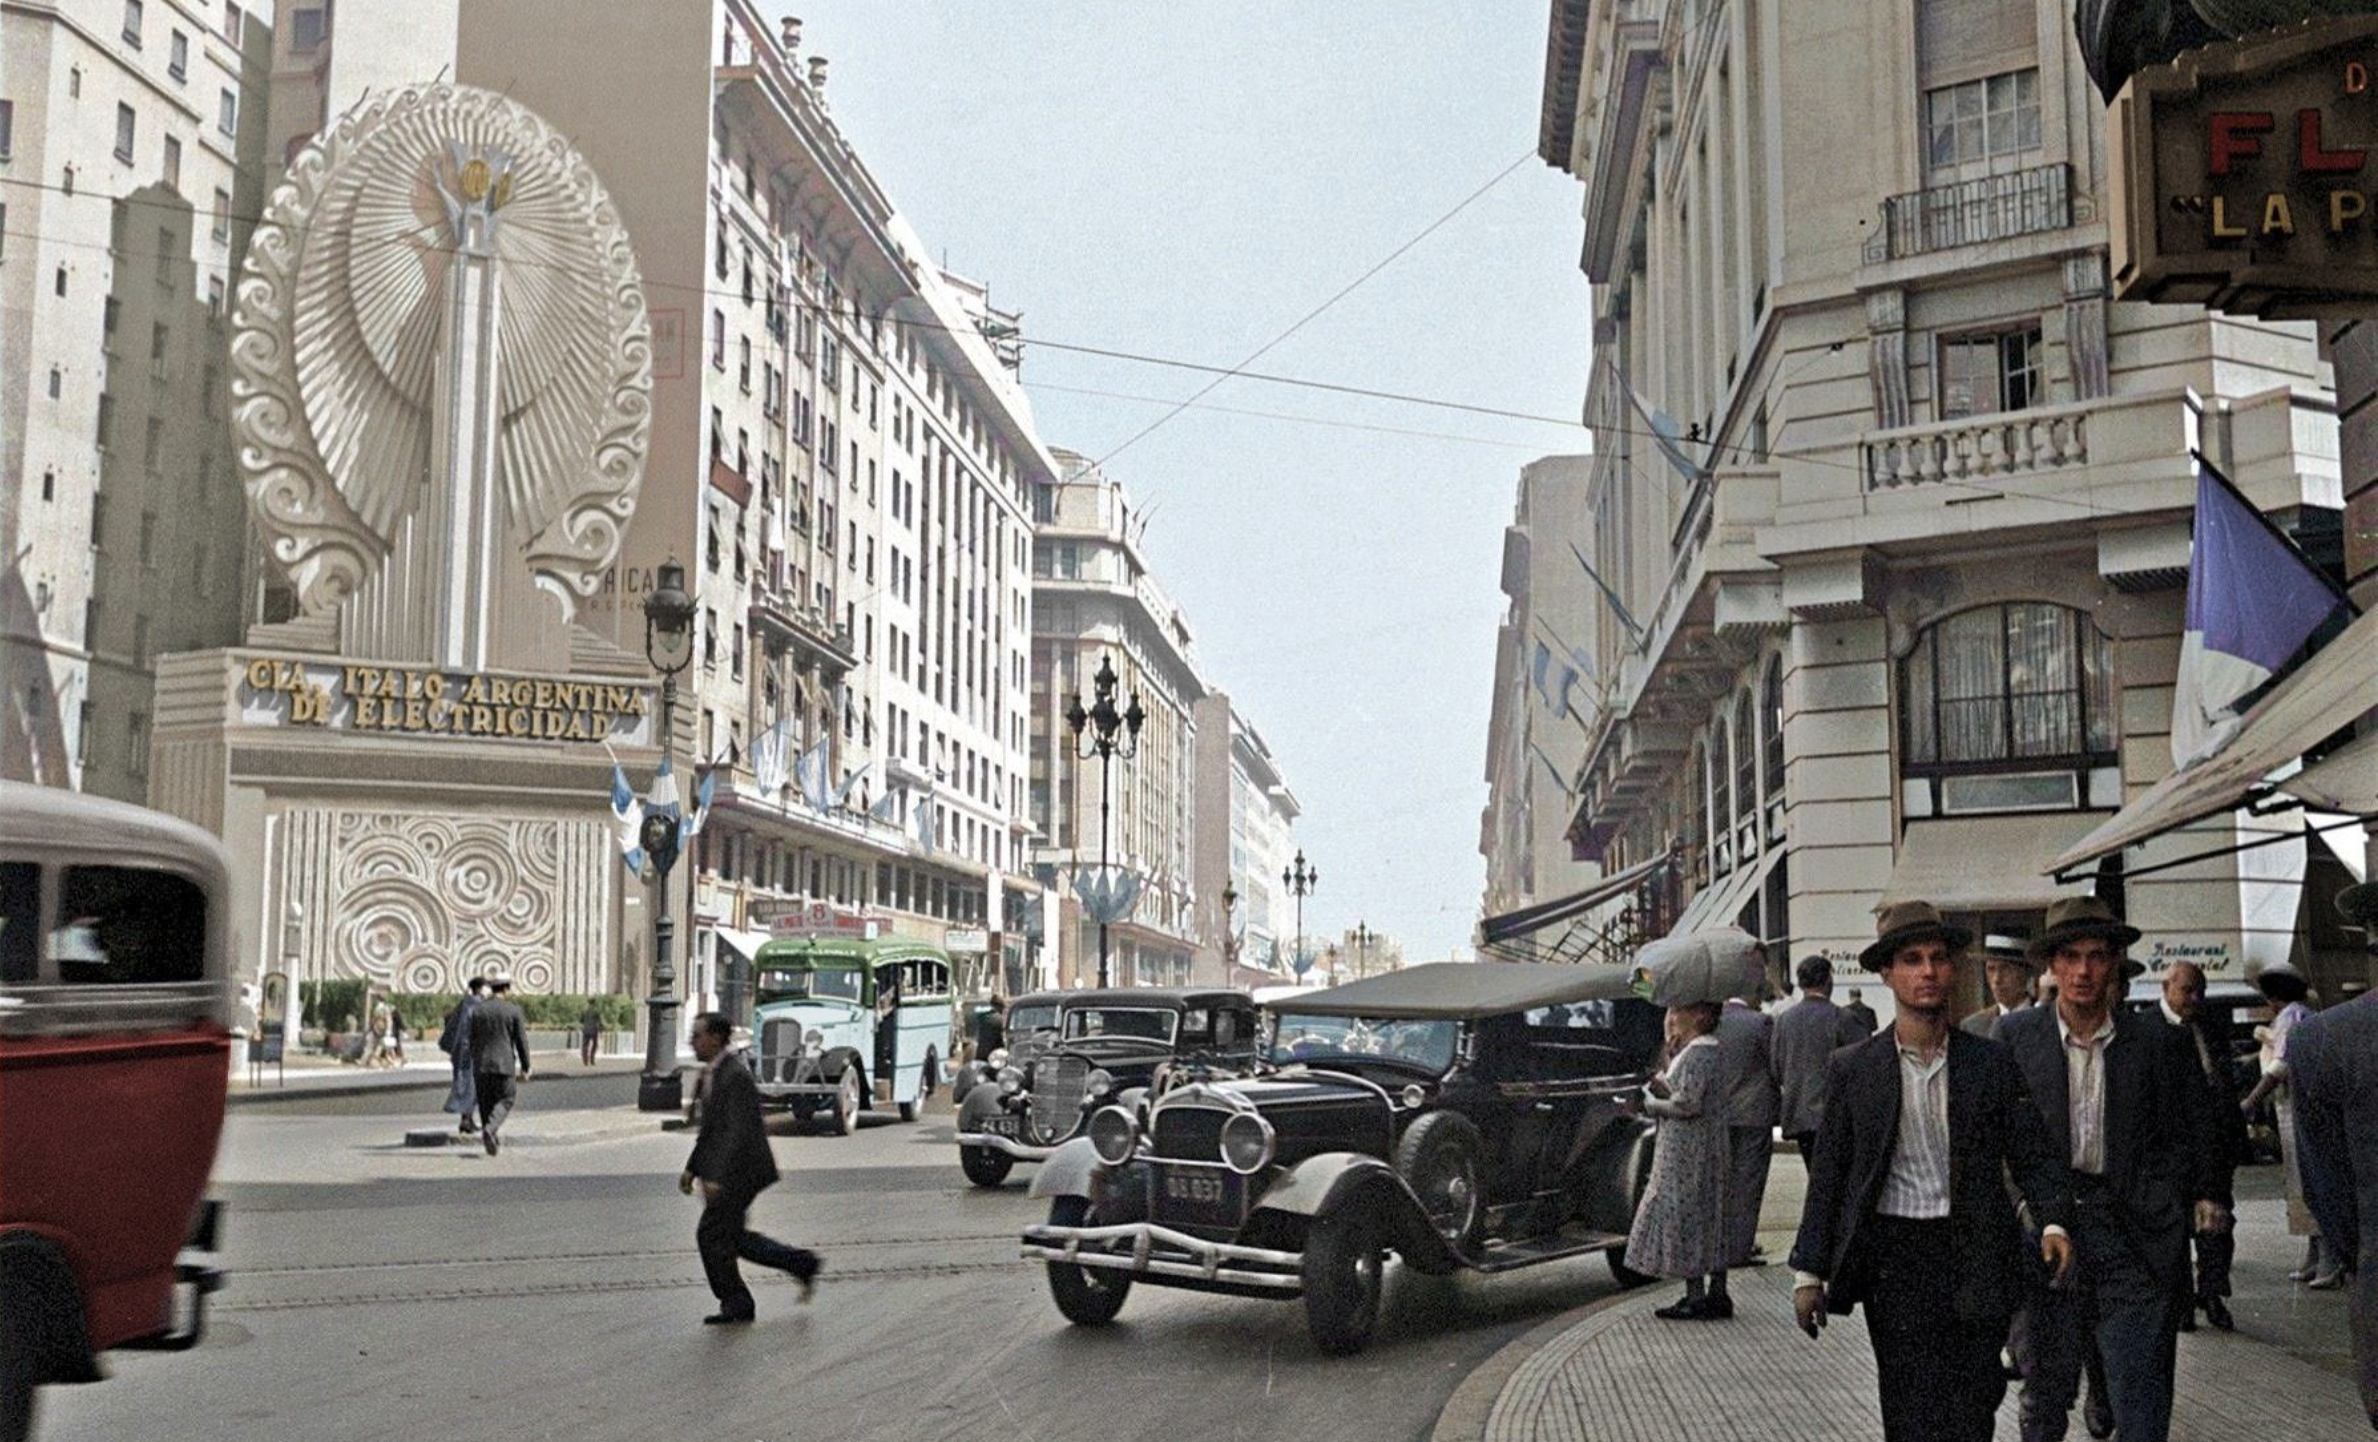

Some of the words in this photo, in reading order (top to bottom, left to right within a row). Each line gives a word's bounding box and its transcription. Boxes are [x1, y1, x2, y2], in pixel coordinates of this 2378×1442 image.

[344, 665, 445, 700] ITALO
[464, 675, 646, 714] ARGENTINA
[291, 690, 330, 724] DE
[355, 696, 611, 740] ELECTRICIDAD
[2152, 942, 2227, 957] Restaurant
